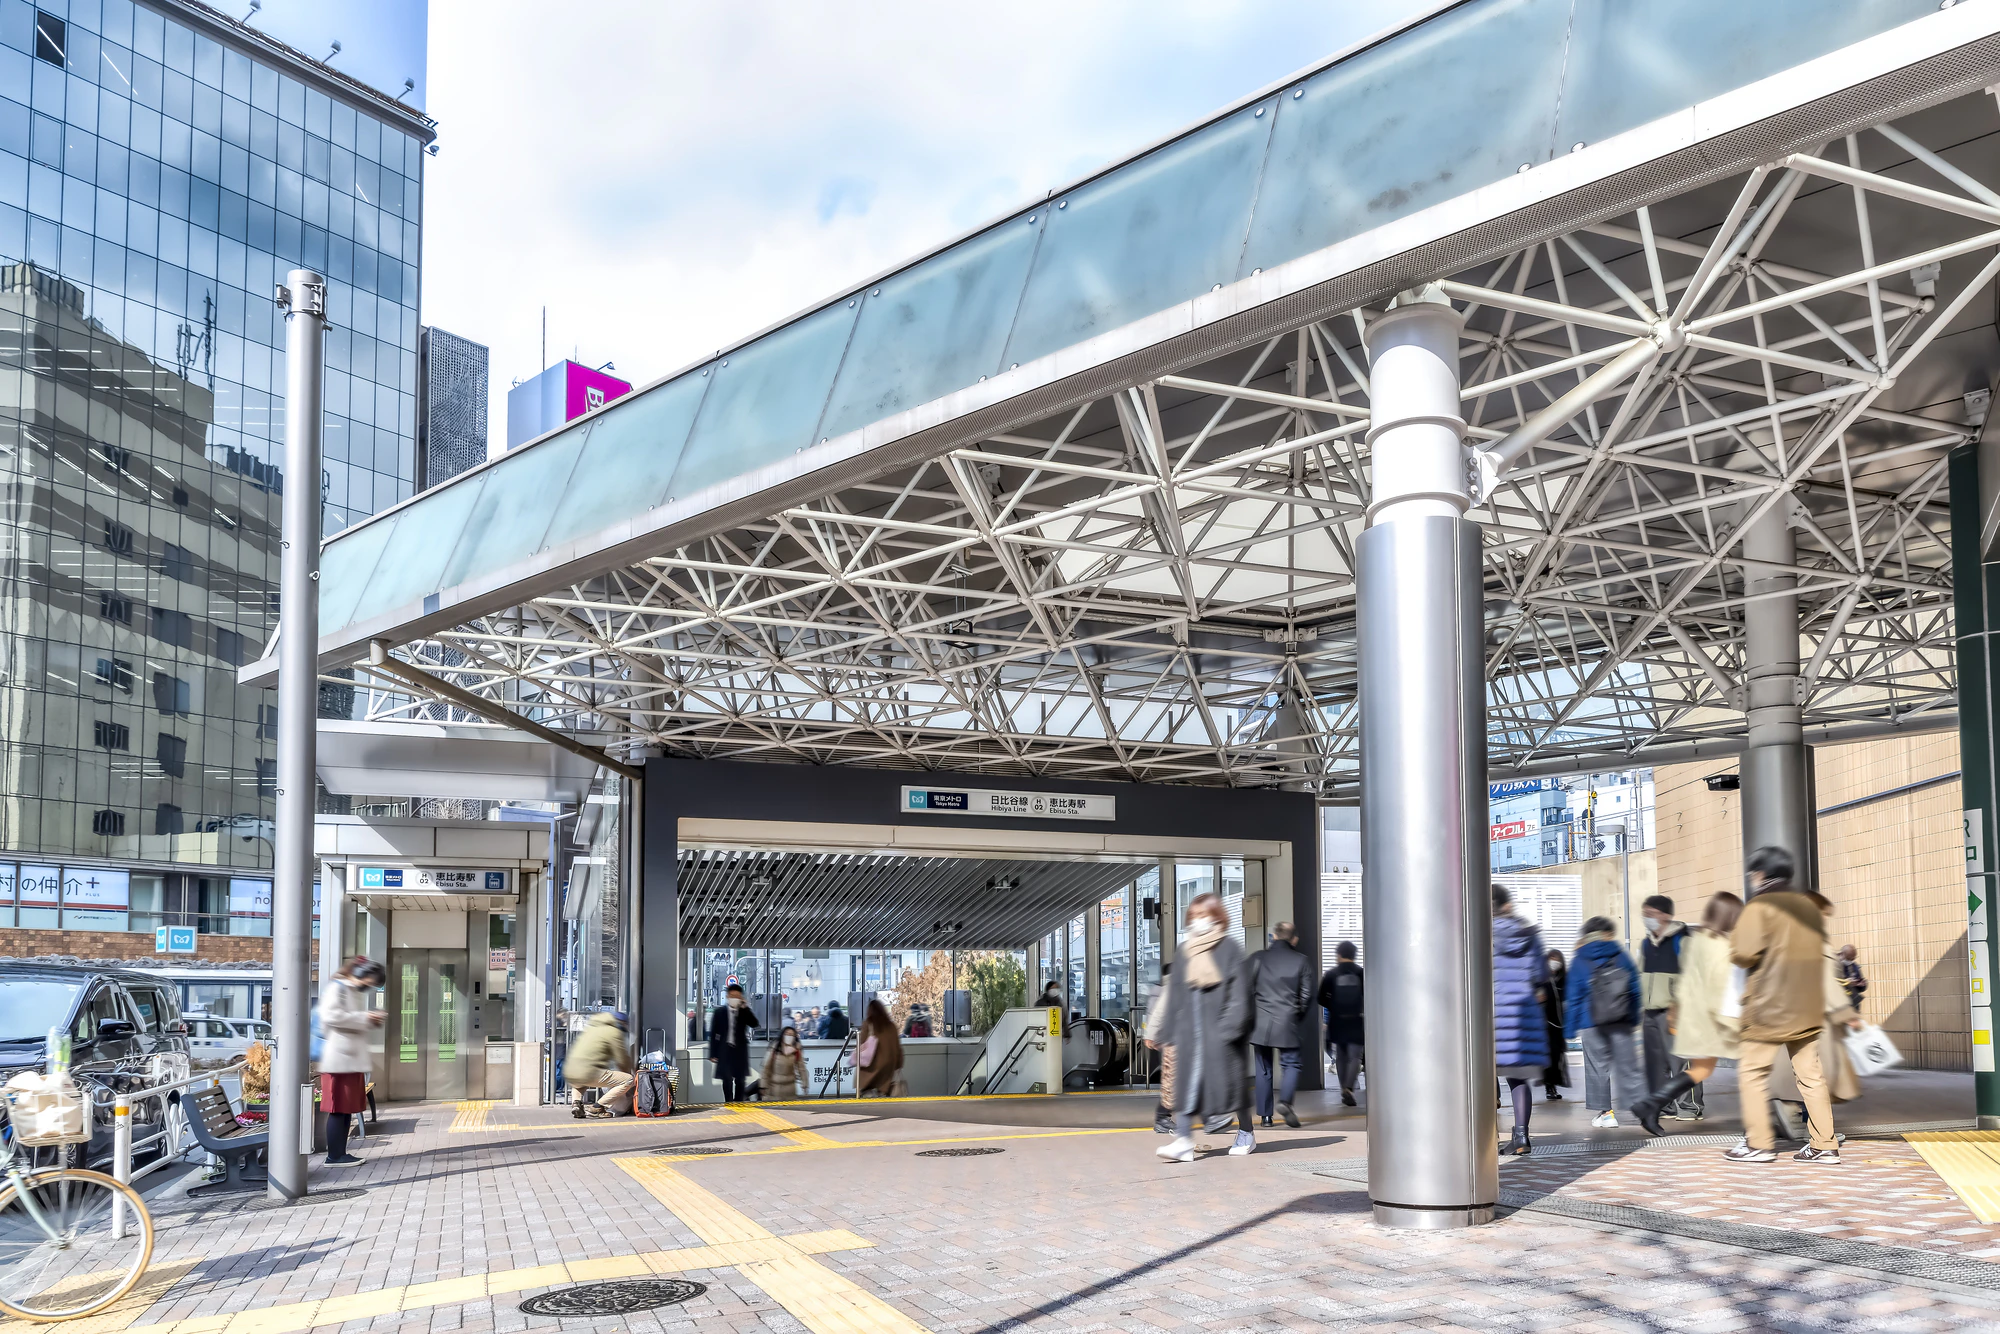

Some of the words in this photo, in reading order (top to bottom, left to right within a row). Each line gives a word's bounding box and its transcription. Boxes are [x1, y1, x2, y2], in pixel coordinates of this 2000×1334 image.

[933, 794, 962, 802] 東京メトロ
[991, 795, 1028, 806] 日比谷線
[1049, 798, 1086, 808] 恵比寿駅
[991, 805, 1012, 813] Hibiya
[1492, 824, 1524, 838] アイフル
[435, 872, 476, 882] 恵比寿駅
